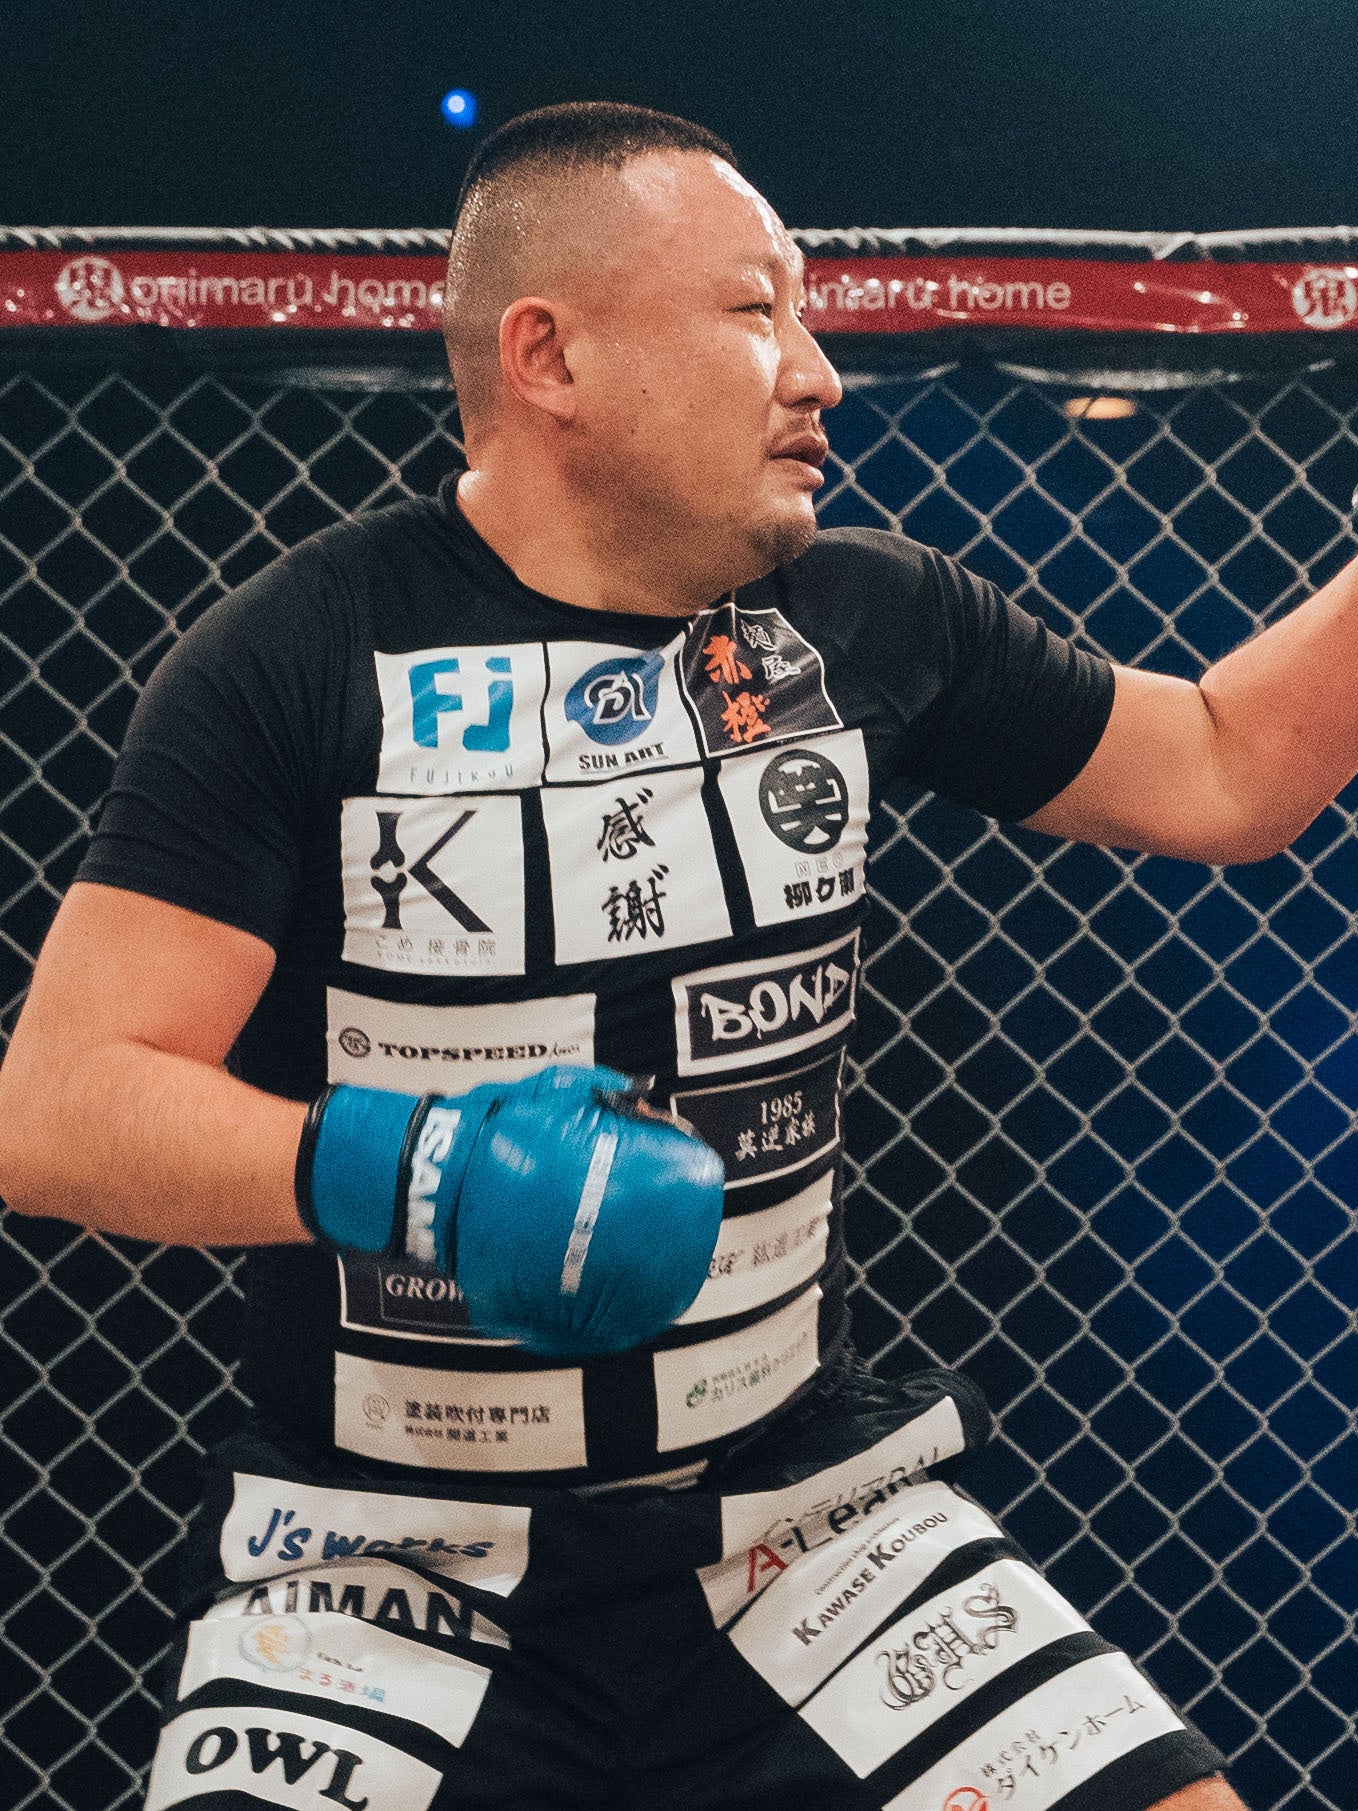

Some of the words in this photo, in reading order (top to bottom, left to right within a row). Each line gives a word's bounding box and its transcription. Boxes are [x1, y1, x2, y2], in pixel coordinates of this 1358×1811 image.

[131, 267, 313, 306] onimaru
[949, 272, 1072, 311] home
[578, 751, 619, 770] SUN
[624, 741, 665, 764] ART
[700, 962, 850, 1041] BOND
[378, 1041, 548, 1061] TOPSPEED
[760, 1090, 803, 1125] 1985
[248, 1508, 311, 1561] J's
[792, 1566, 877, 1646] KAWASE
[866, 1511, 949, 1571] KOUBOU
[186, 1726, 369, 1811] OWL
[997, 1694, 1147, 1801] ダイケンホーム
